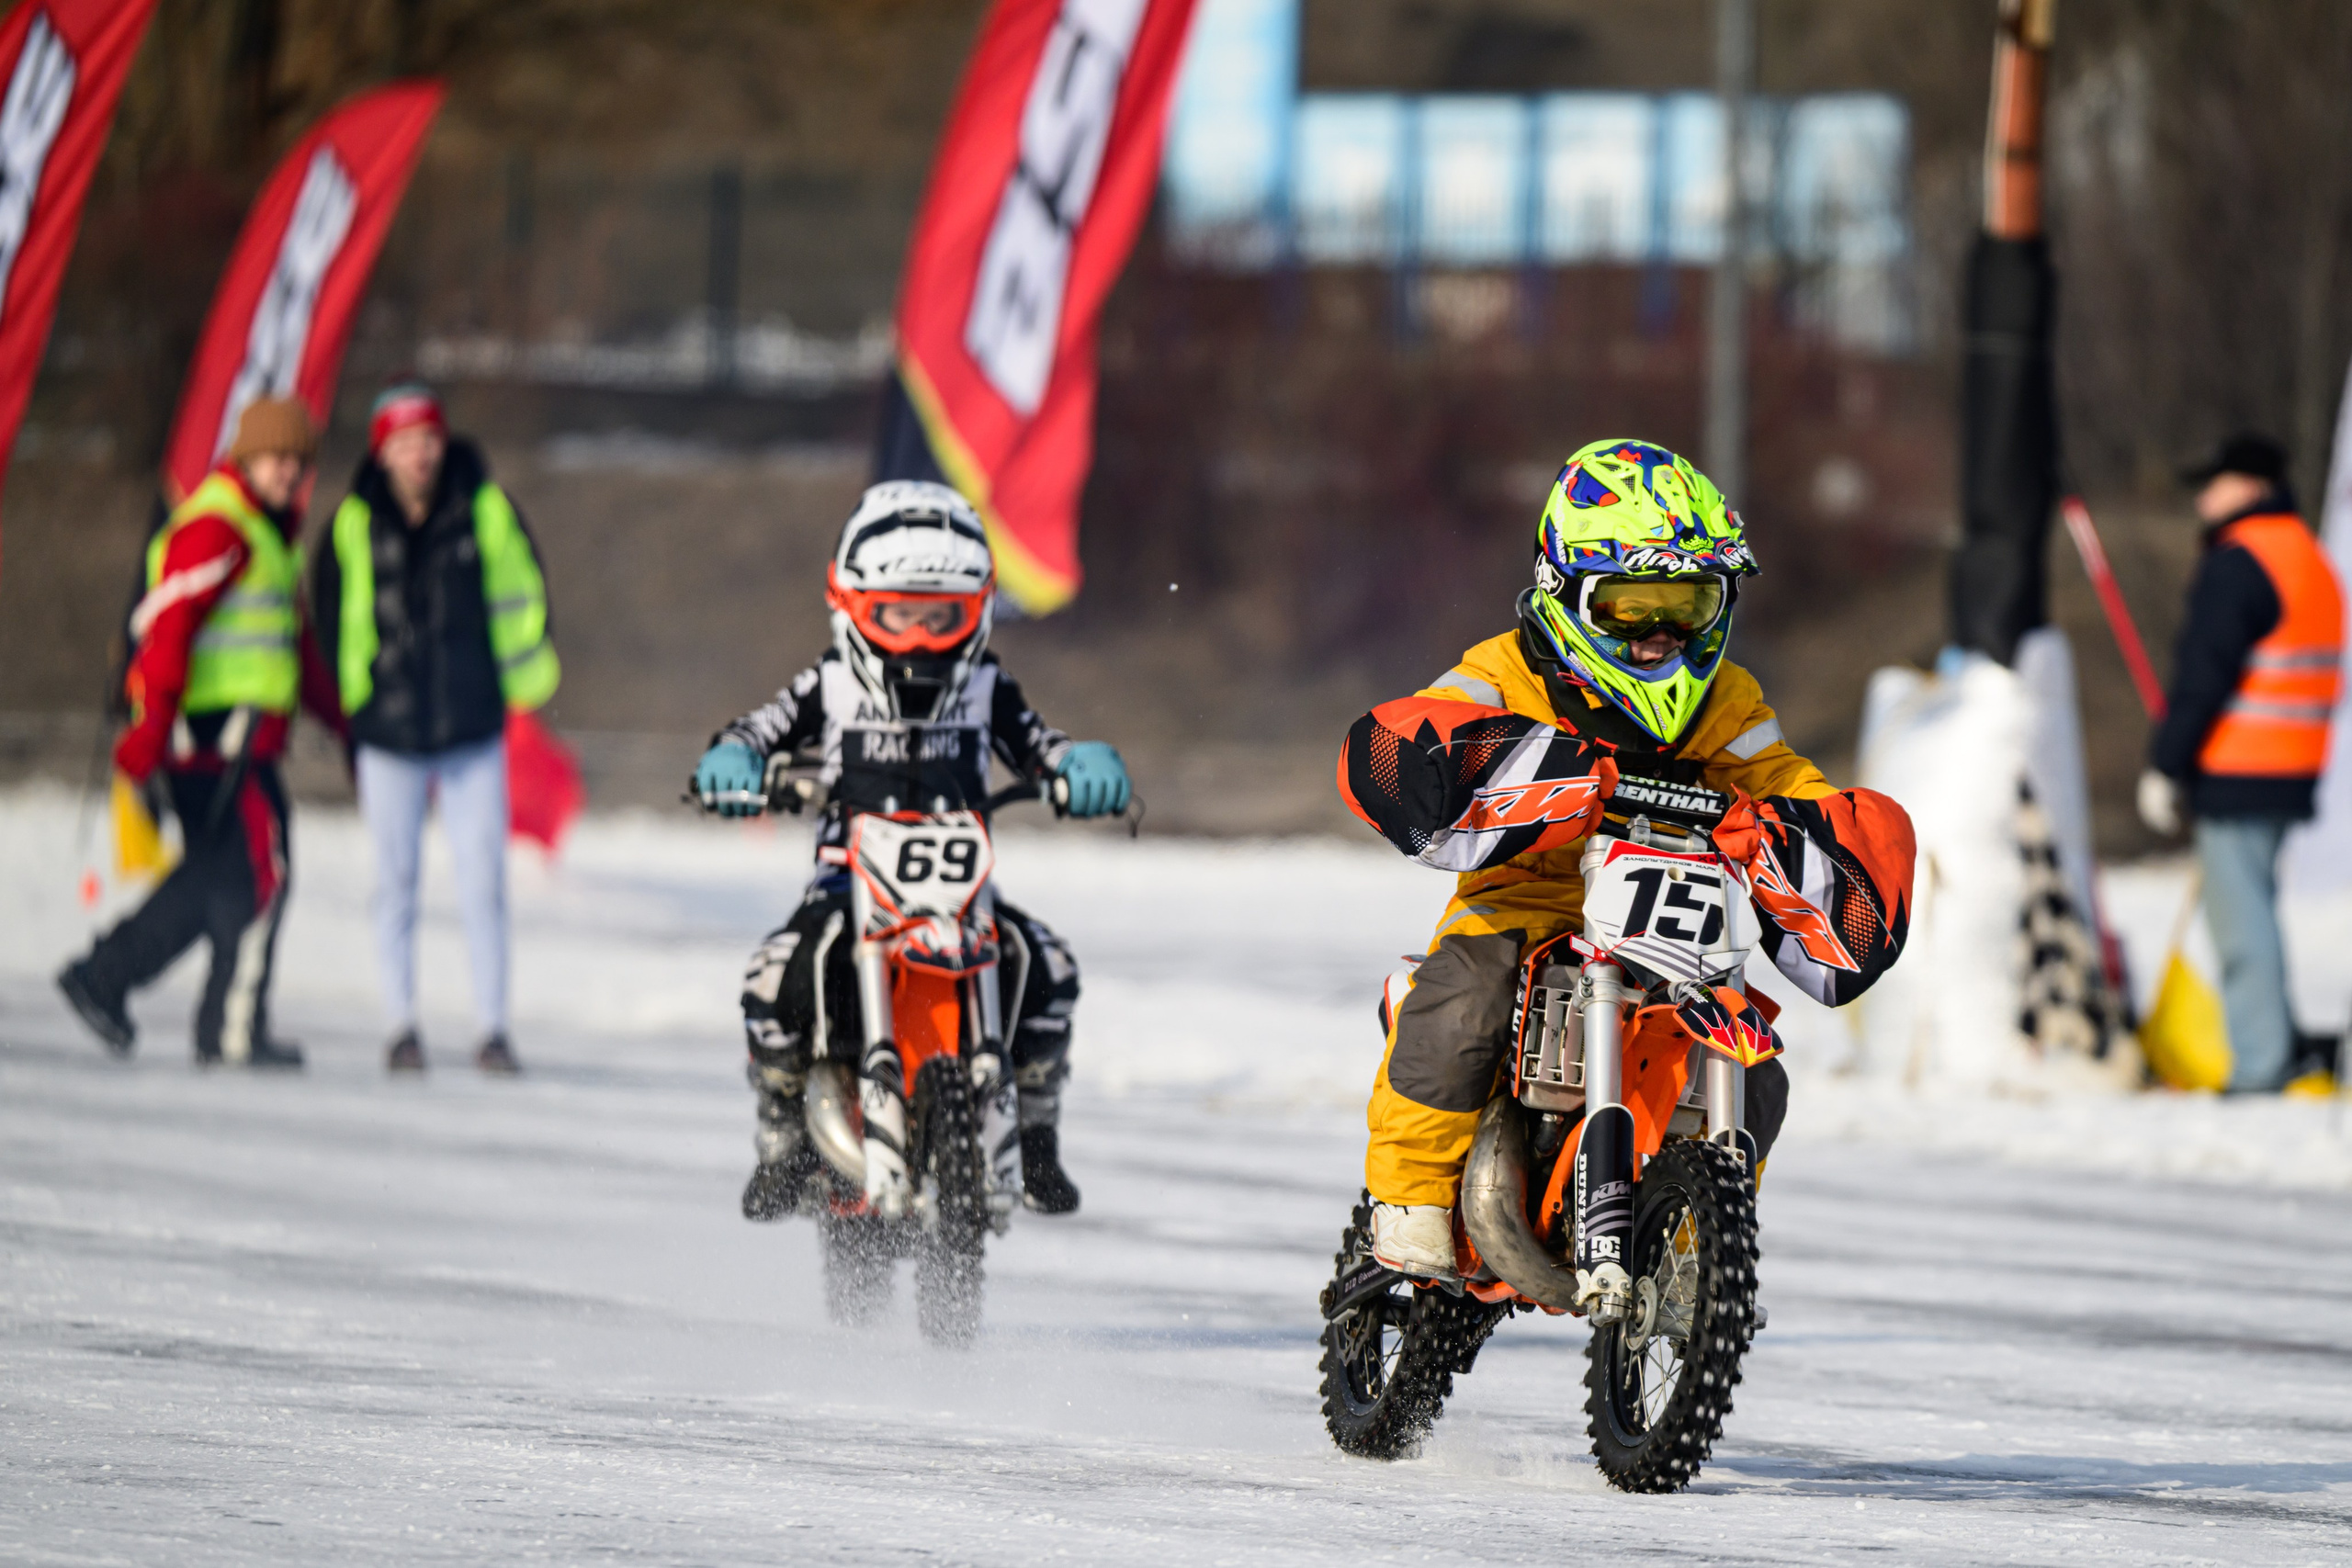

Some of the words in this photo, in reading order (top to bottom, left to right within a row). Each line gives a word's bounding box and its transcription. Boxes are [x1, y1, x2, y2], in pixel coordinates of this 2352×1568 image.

[1624, 547, 1698, 571] Airoh
[896, 837, 978, 883] 69
[1621, 867, 1729, 946] 15
[1577, 1153, 1588, 1258] DUNLOP
[1590, 1180, 1632, 1204] KTM
